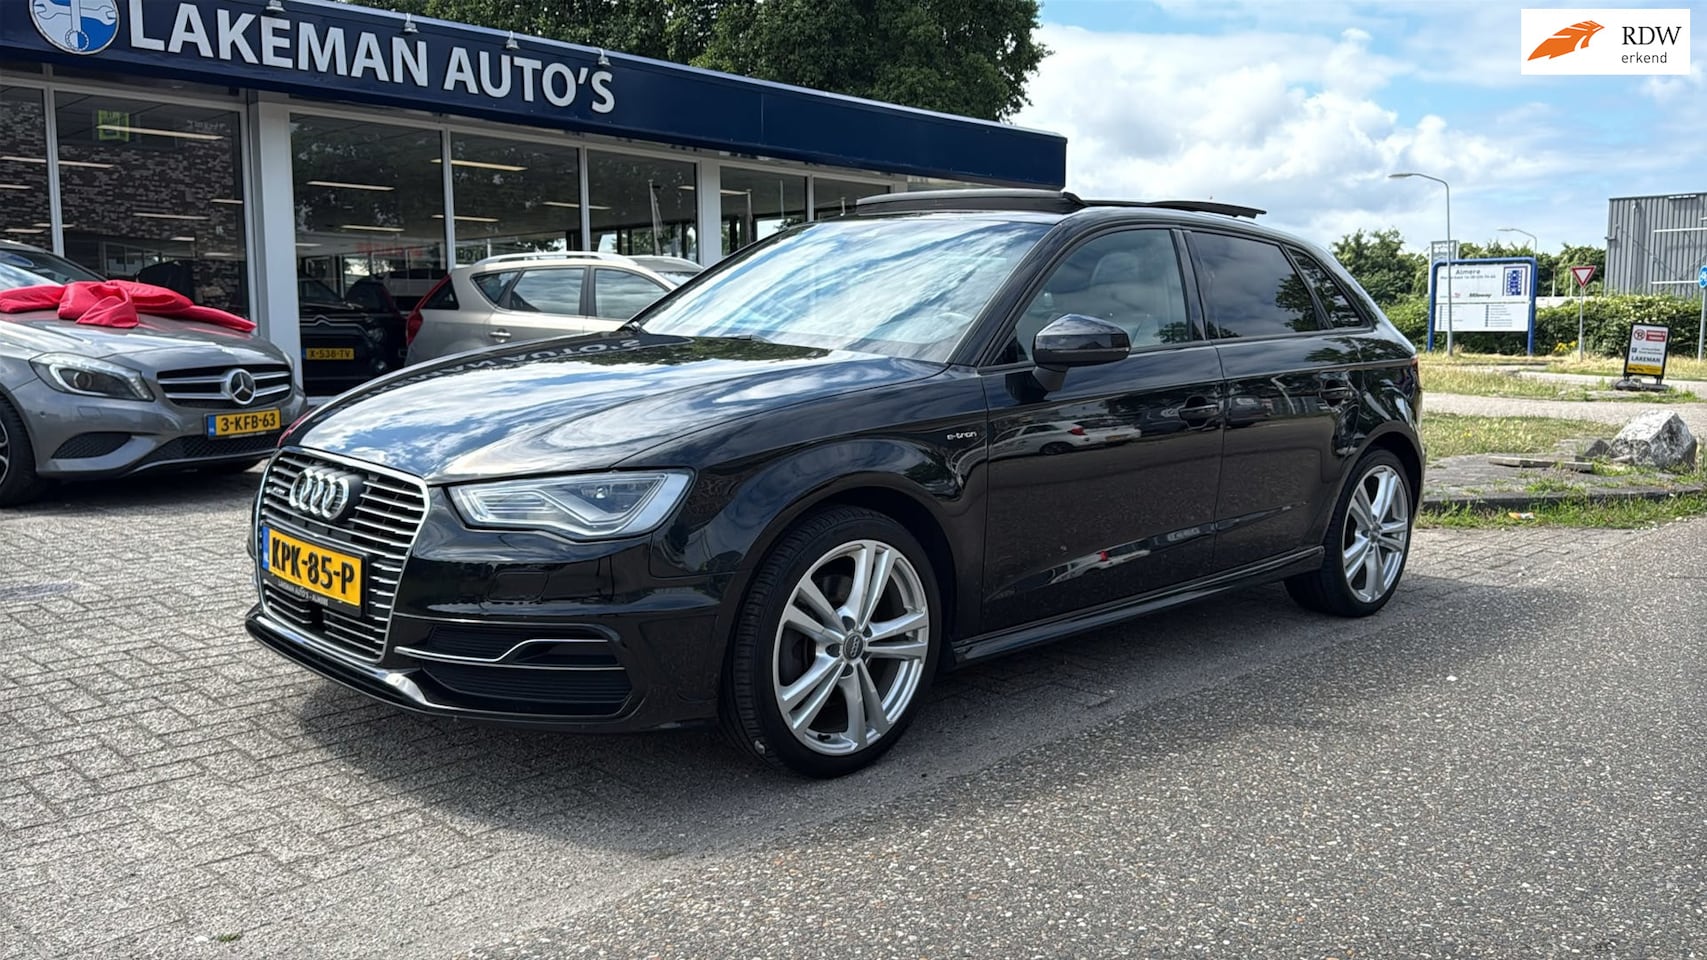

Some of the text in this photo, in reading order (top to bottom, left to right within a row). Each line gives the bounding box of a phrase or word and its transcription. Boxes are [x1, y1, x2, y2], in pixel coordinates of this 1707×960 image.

[129, 0, 616, 114] LAKEMAN AUTO'S
[1631, 355, 1661, 363] LAKEMAN
[221, 413, 276, 432] 3-KFB-63
[946, 431, 977, 440] e-tron
[272, 537, 355, 594] KPK-85-P
